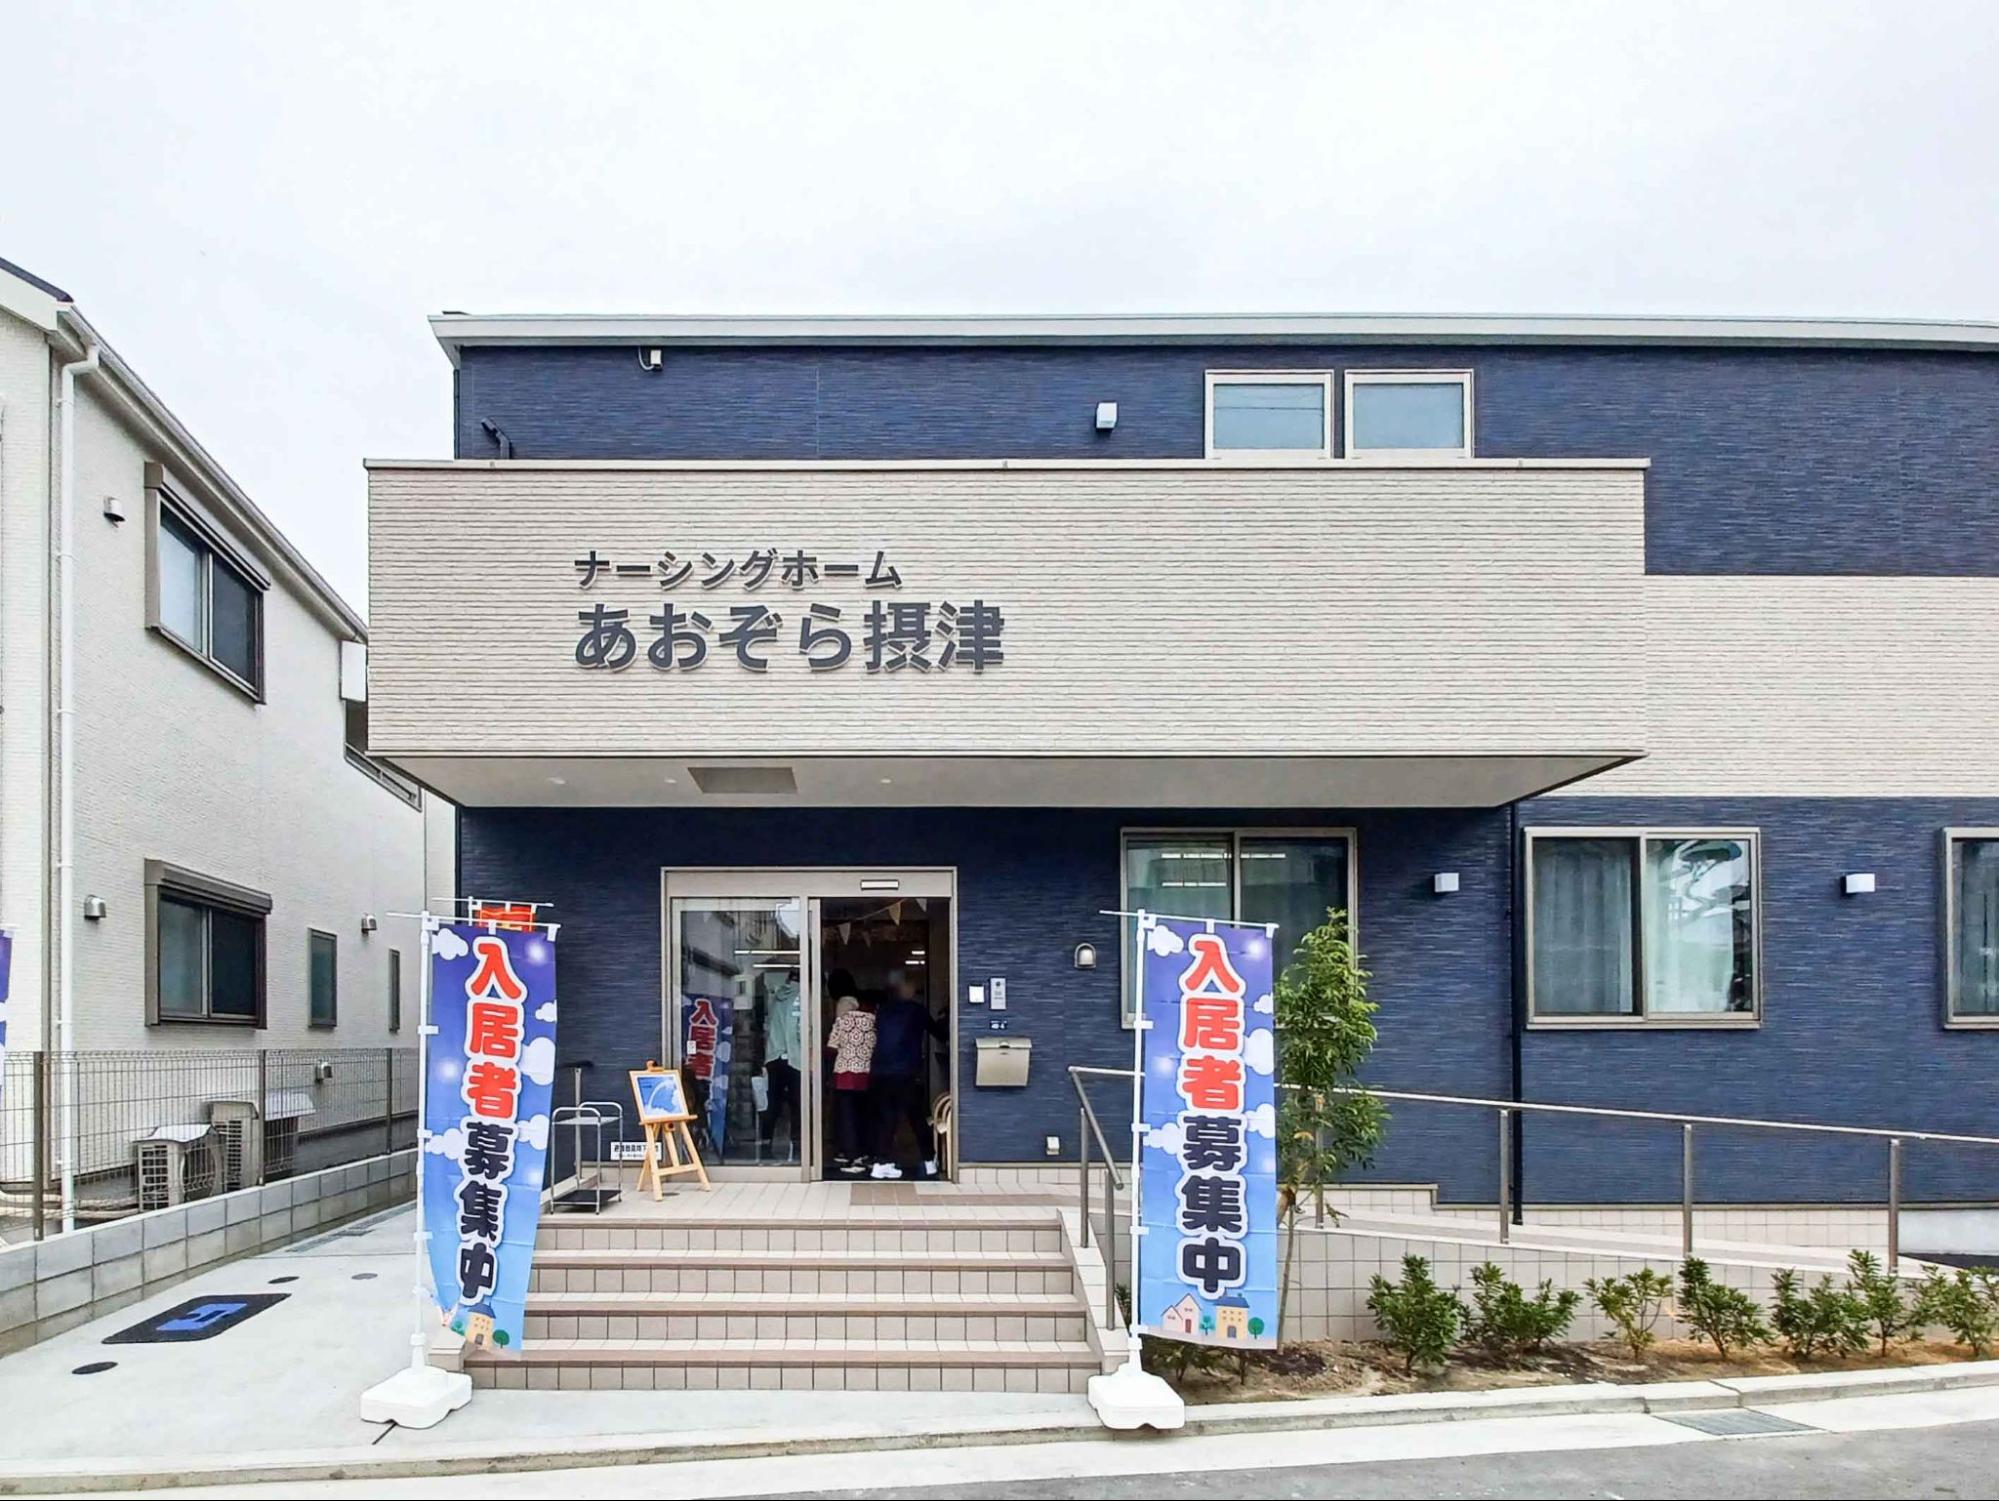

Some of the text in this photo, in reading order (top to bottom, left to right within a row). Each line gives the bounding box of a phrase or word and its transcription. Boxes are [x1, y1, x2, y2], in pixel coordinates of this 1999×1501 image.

[573, 548, 903, 589] ナーシングホーム
[575, 600, 1005, 673] あおぞら摂津
[459, 941, 522, 1298] 入居者募集中
[1181, 940, 1242, 1294] 入居者募集中
